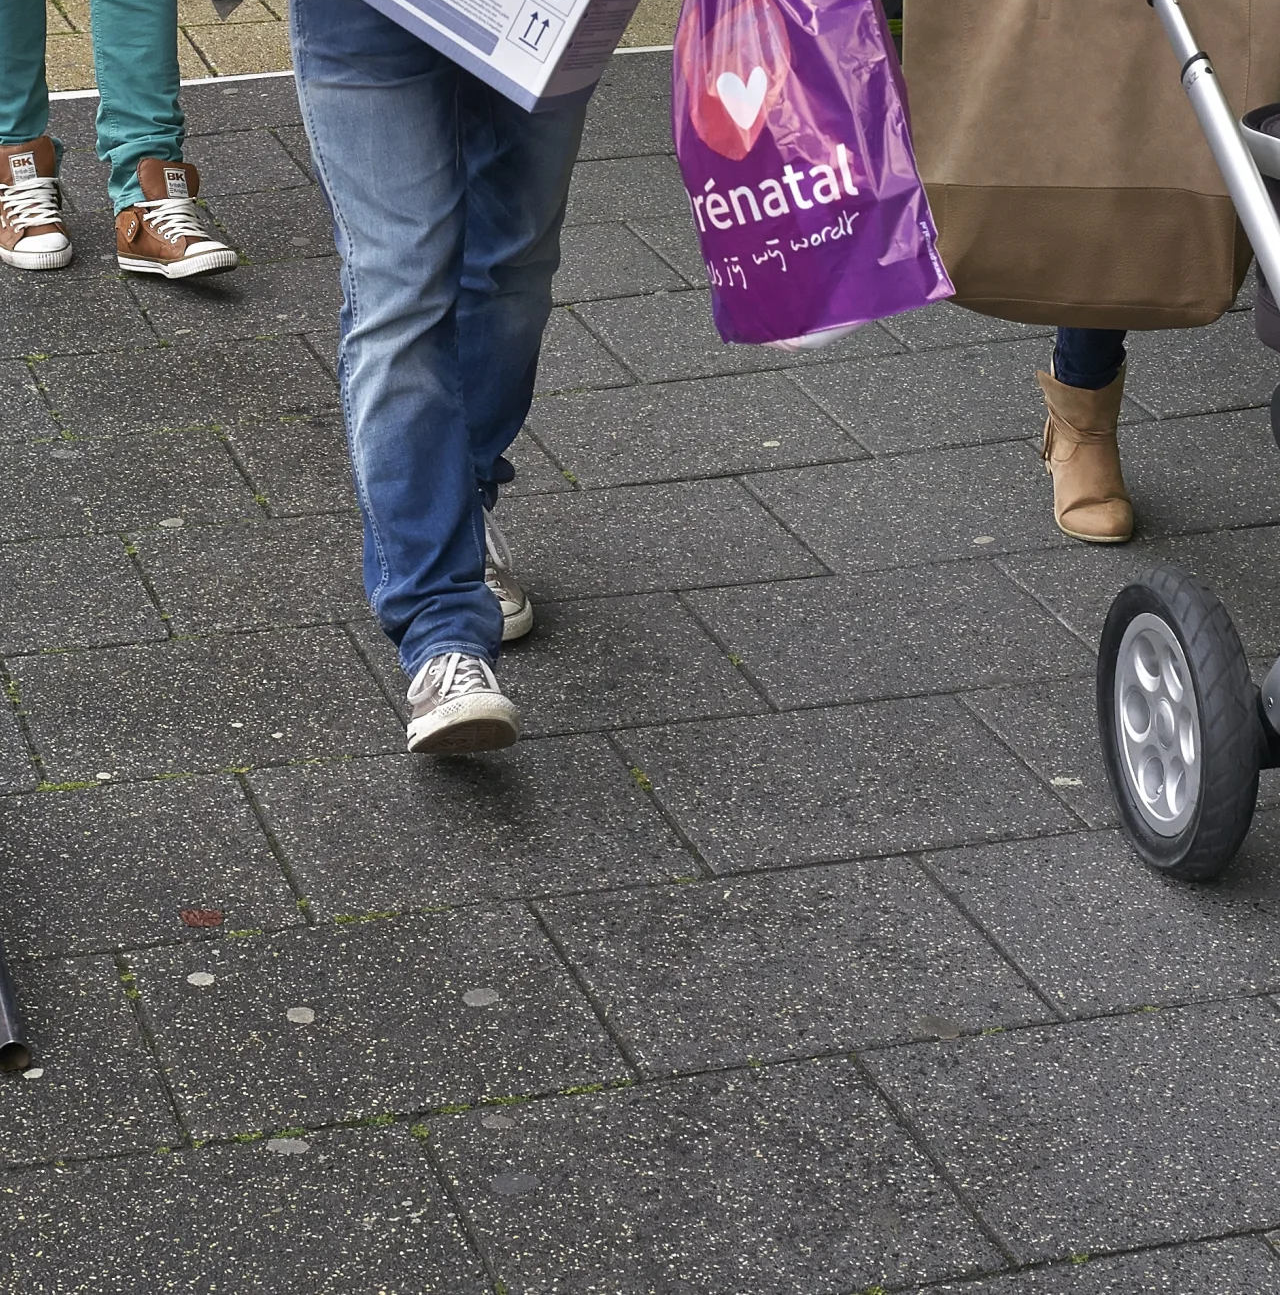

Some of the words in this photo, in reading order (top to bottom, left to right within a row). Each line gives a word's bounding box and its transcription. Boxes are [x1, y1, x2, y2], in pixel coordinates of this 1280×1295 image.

[13, 157, 33, 168] BK
[167, 172, 185, 182] BK
[692, 143, 860, 233] rénatal
